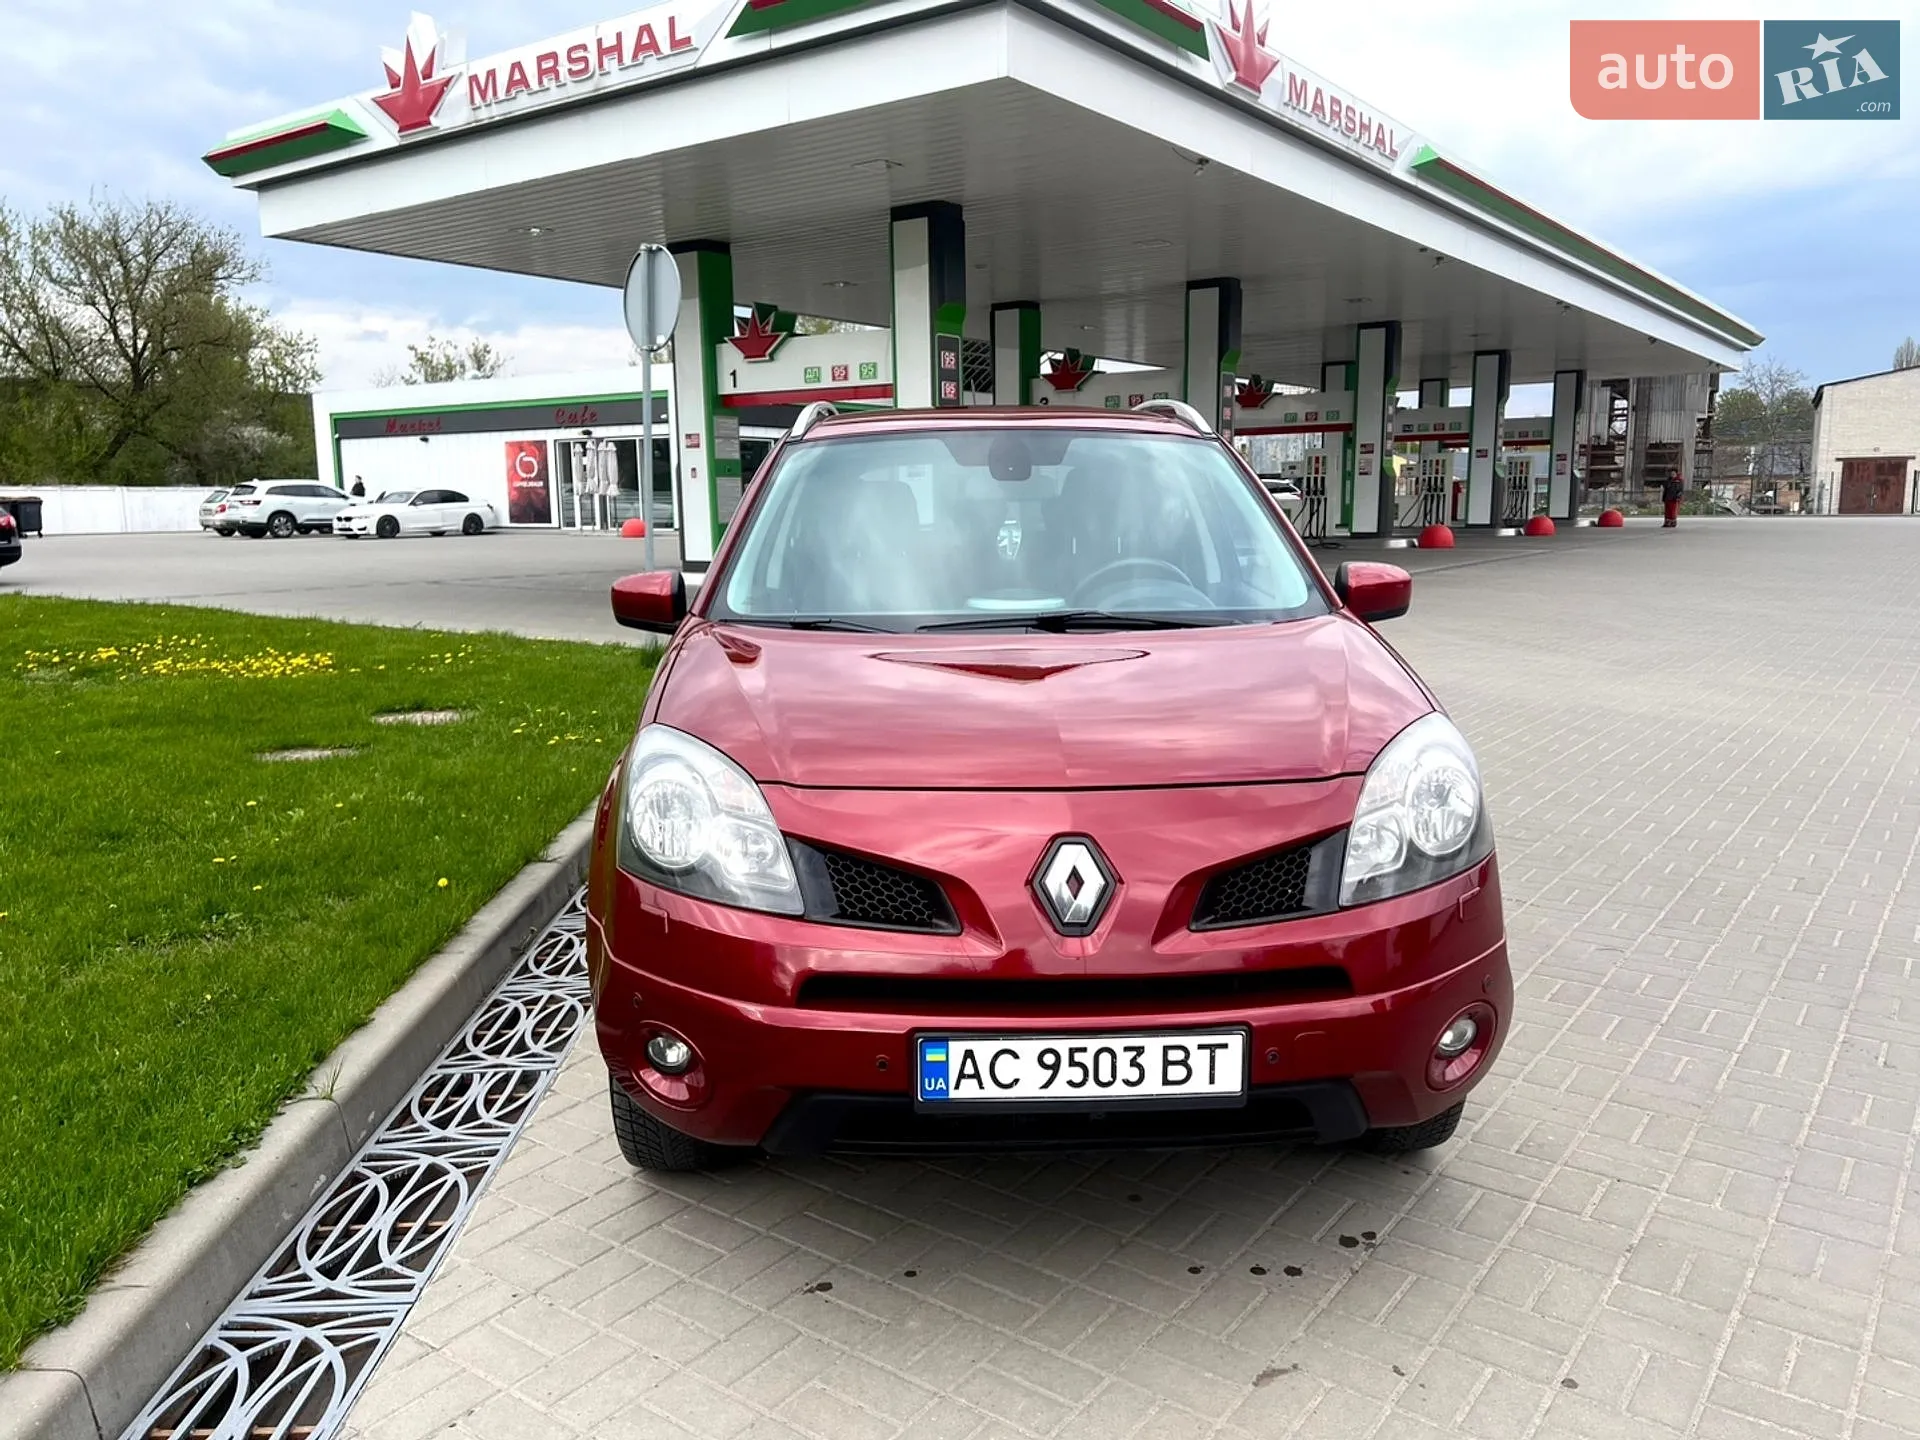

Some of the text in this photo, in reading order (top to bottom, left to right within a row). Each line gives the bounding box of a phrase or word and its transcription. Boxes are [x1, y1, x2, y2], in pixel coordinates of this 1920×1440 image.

[468, 16, 692, 107] MARSHAL
[1288, 71, 1398, 158] MARSHAL
[729, 369, 737, 388] 1
[924, 1077, 947, 1091] UA
[954, 1043, 1229, 1090] AC 9503 BT
